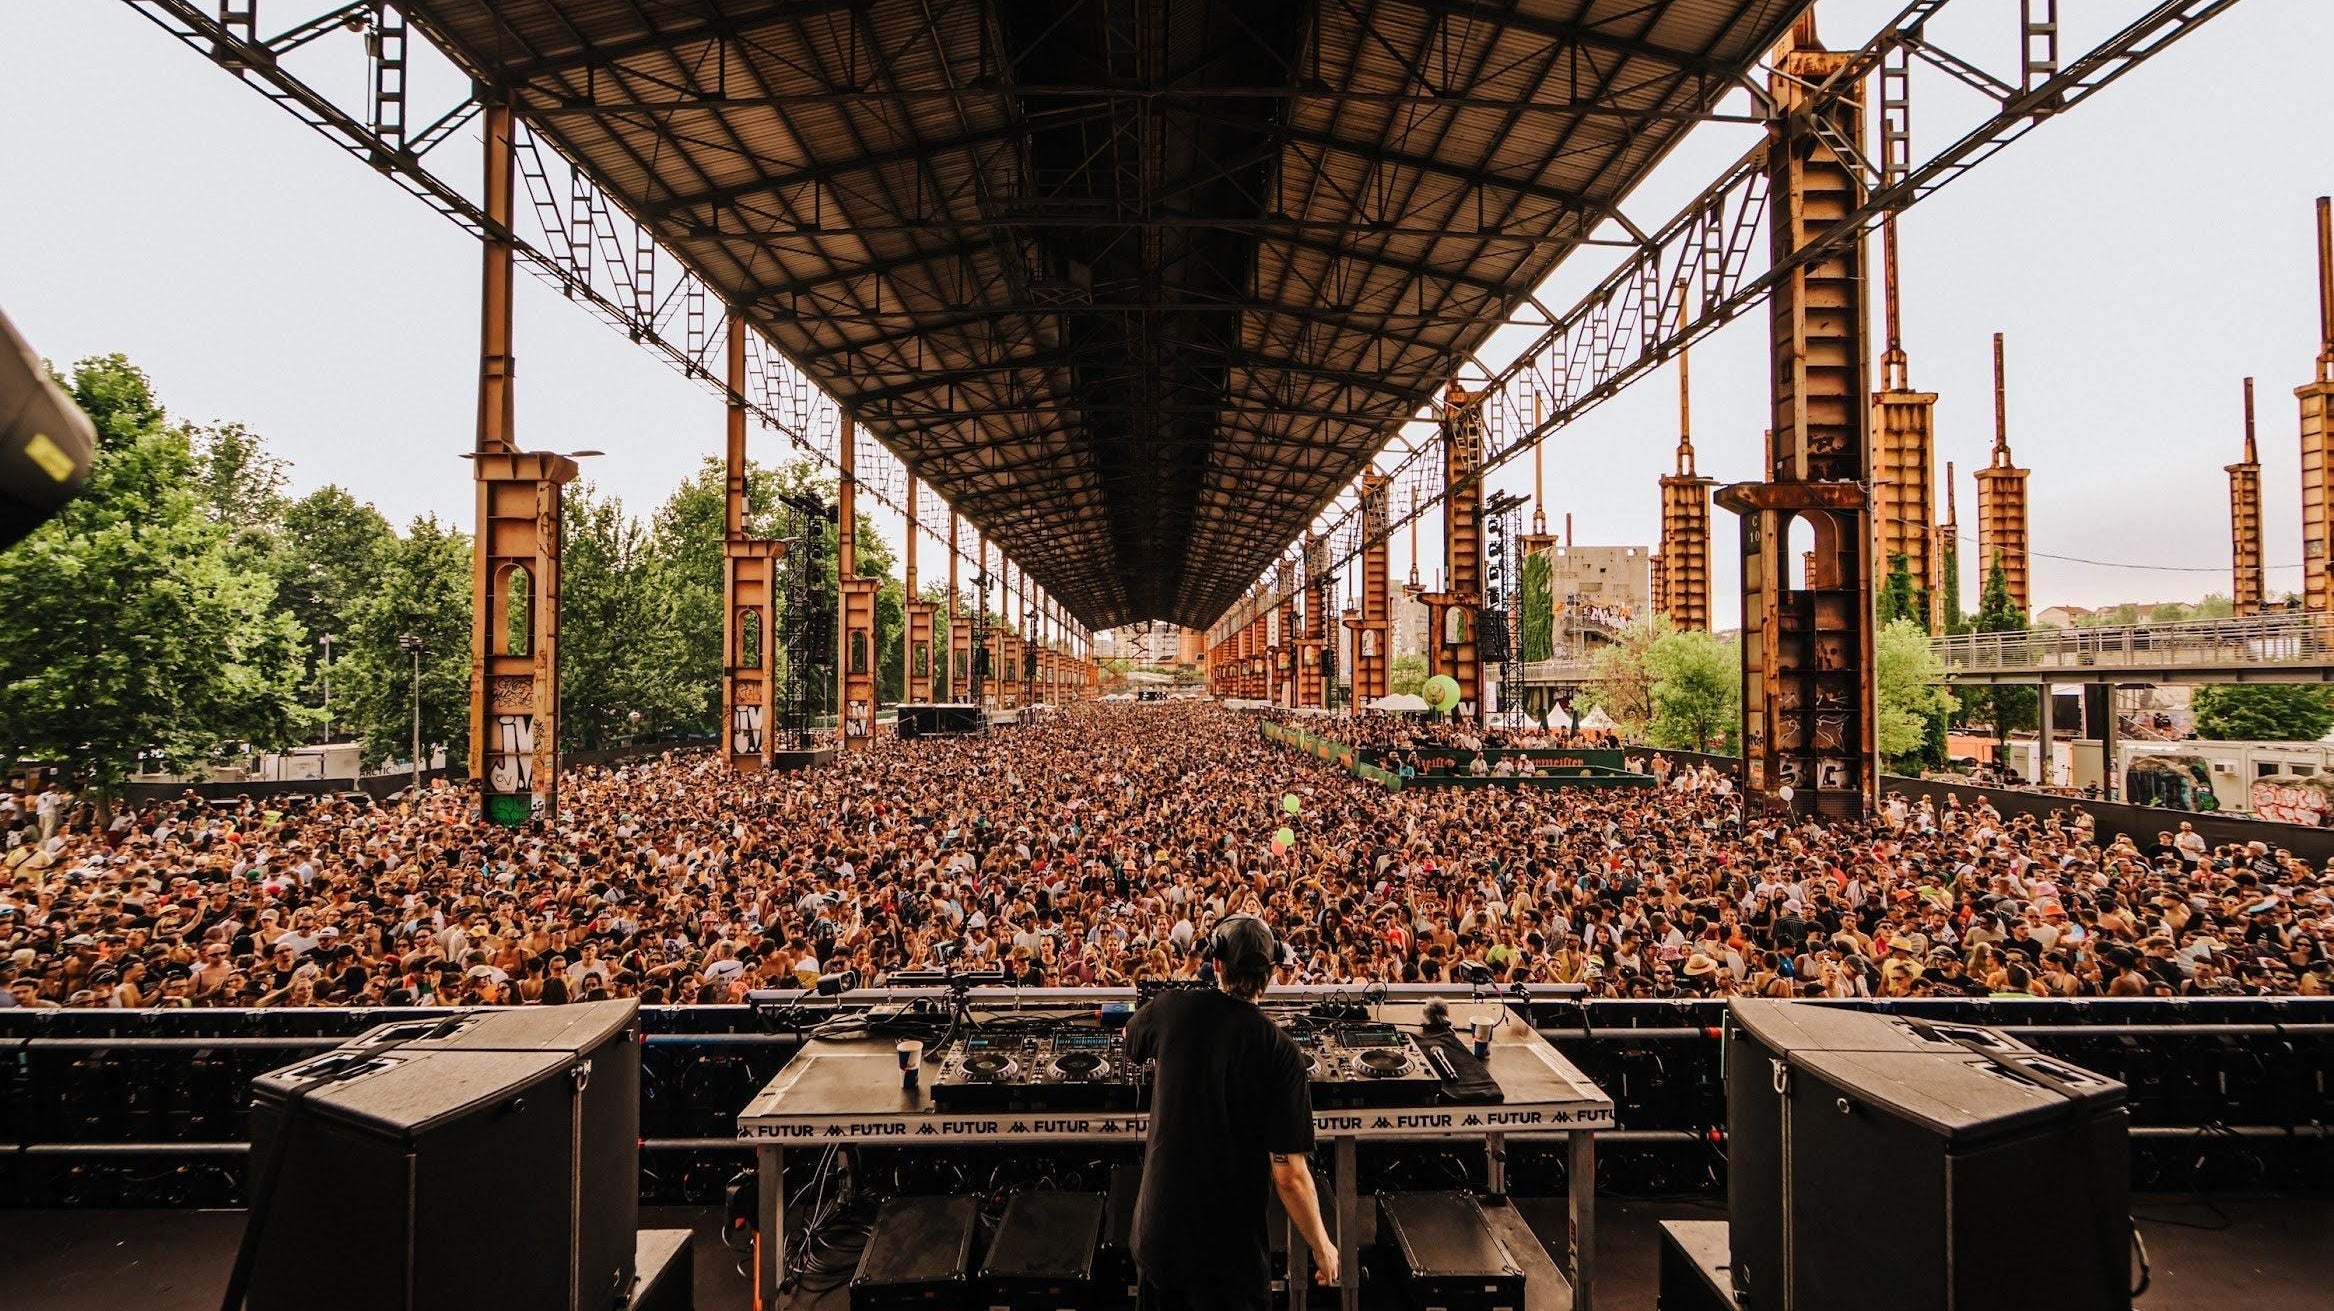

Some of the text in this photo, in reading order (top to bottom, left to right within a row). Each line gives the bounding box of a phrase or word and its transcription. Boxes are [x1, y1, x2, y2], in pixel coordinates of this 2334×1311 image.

[1750, 530, 1760, 543] 10
[758, 1125, 813, 1138] FUTUR
[850, 1124, 906, 1136] FUTUR
[943, 1122, 998, 1134] FUTUR
[1035, 1121, 1090, 1133] FUTUR
[1397, 1114, 1451, 1128] FUTUR
[1487, 1111, 1541, 1125] FUTUR
